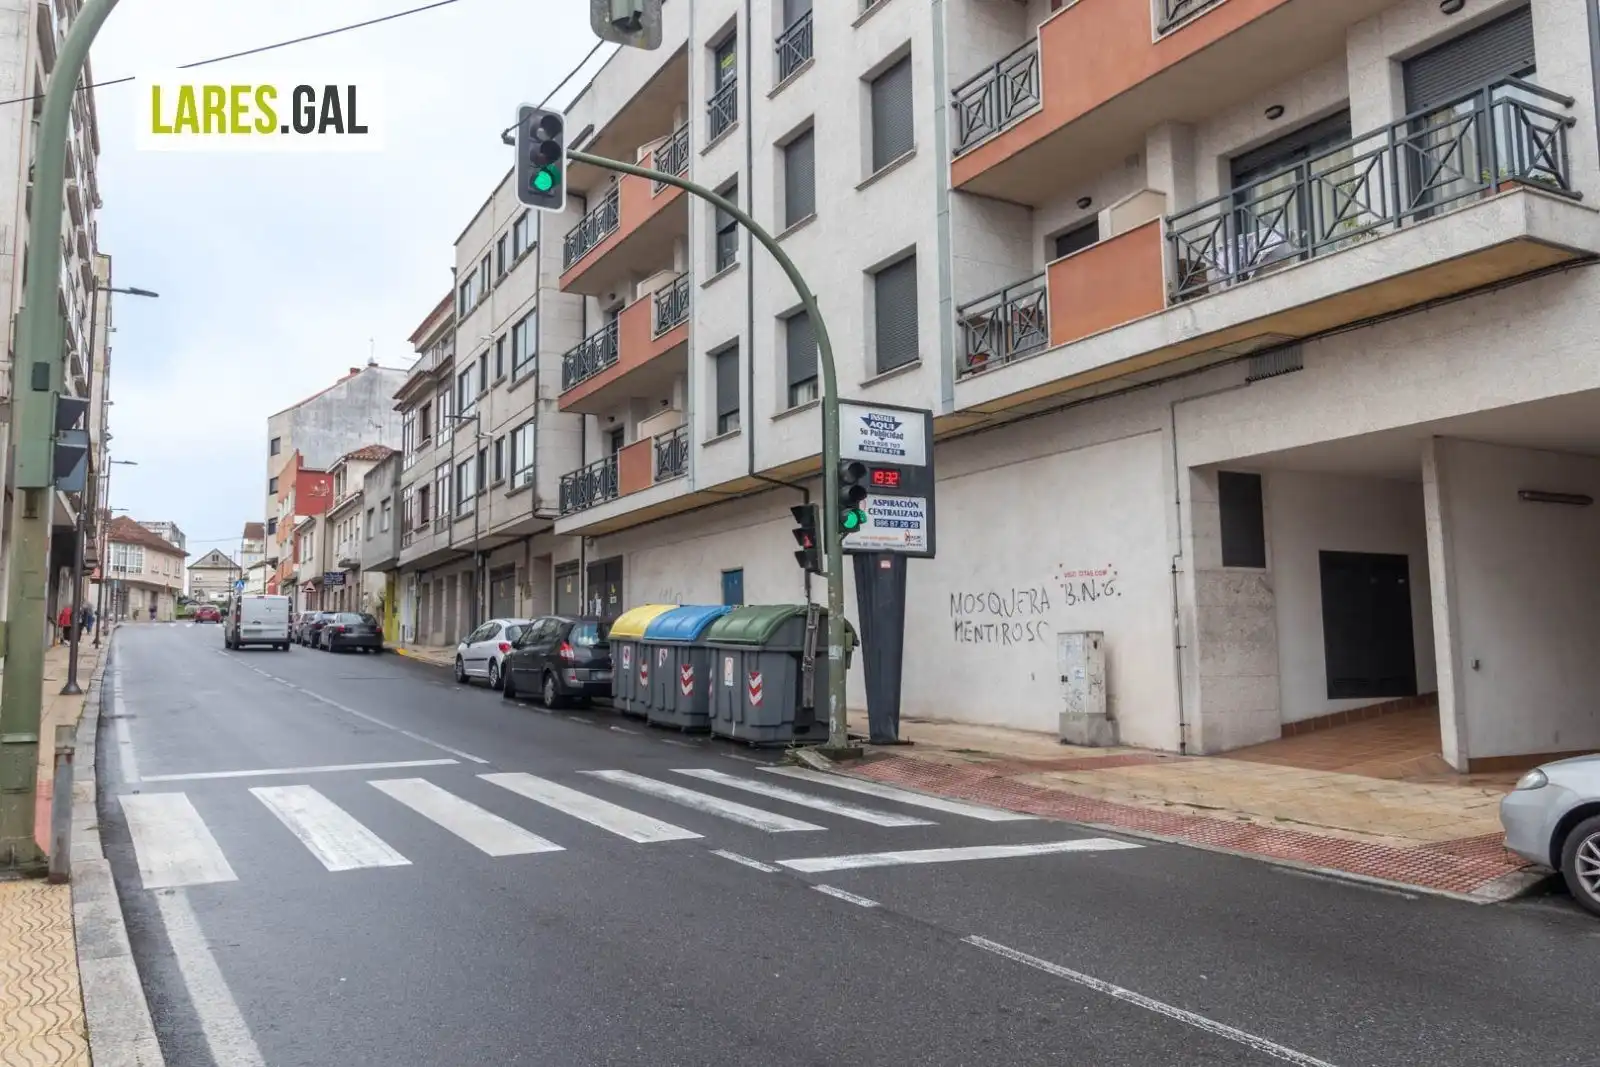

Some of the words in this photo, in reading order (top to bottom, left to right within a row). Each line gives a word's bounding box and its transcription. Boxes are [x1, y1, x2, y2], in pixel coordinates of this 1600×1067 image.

[870, 429, 904, 440] Publicidad
[872, 498, 919, 508] ASPIRACIÓN
[868, 508, 924, 518] CENTRALIZADA
[950, 587, 1050, 618] MOSQUERA
